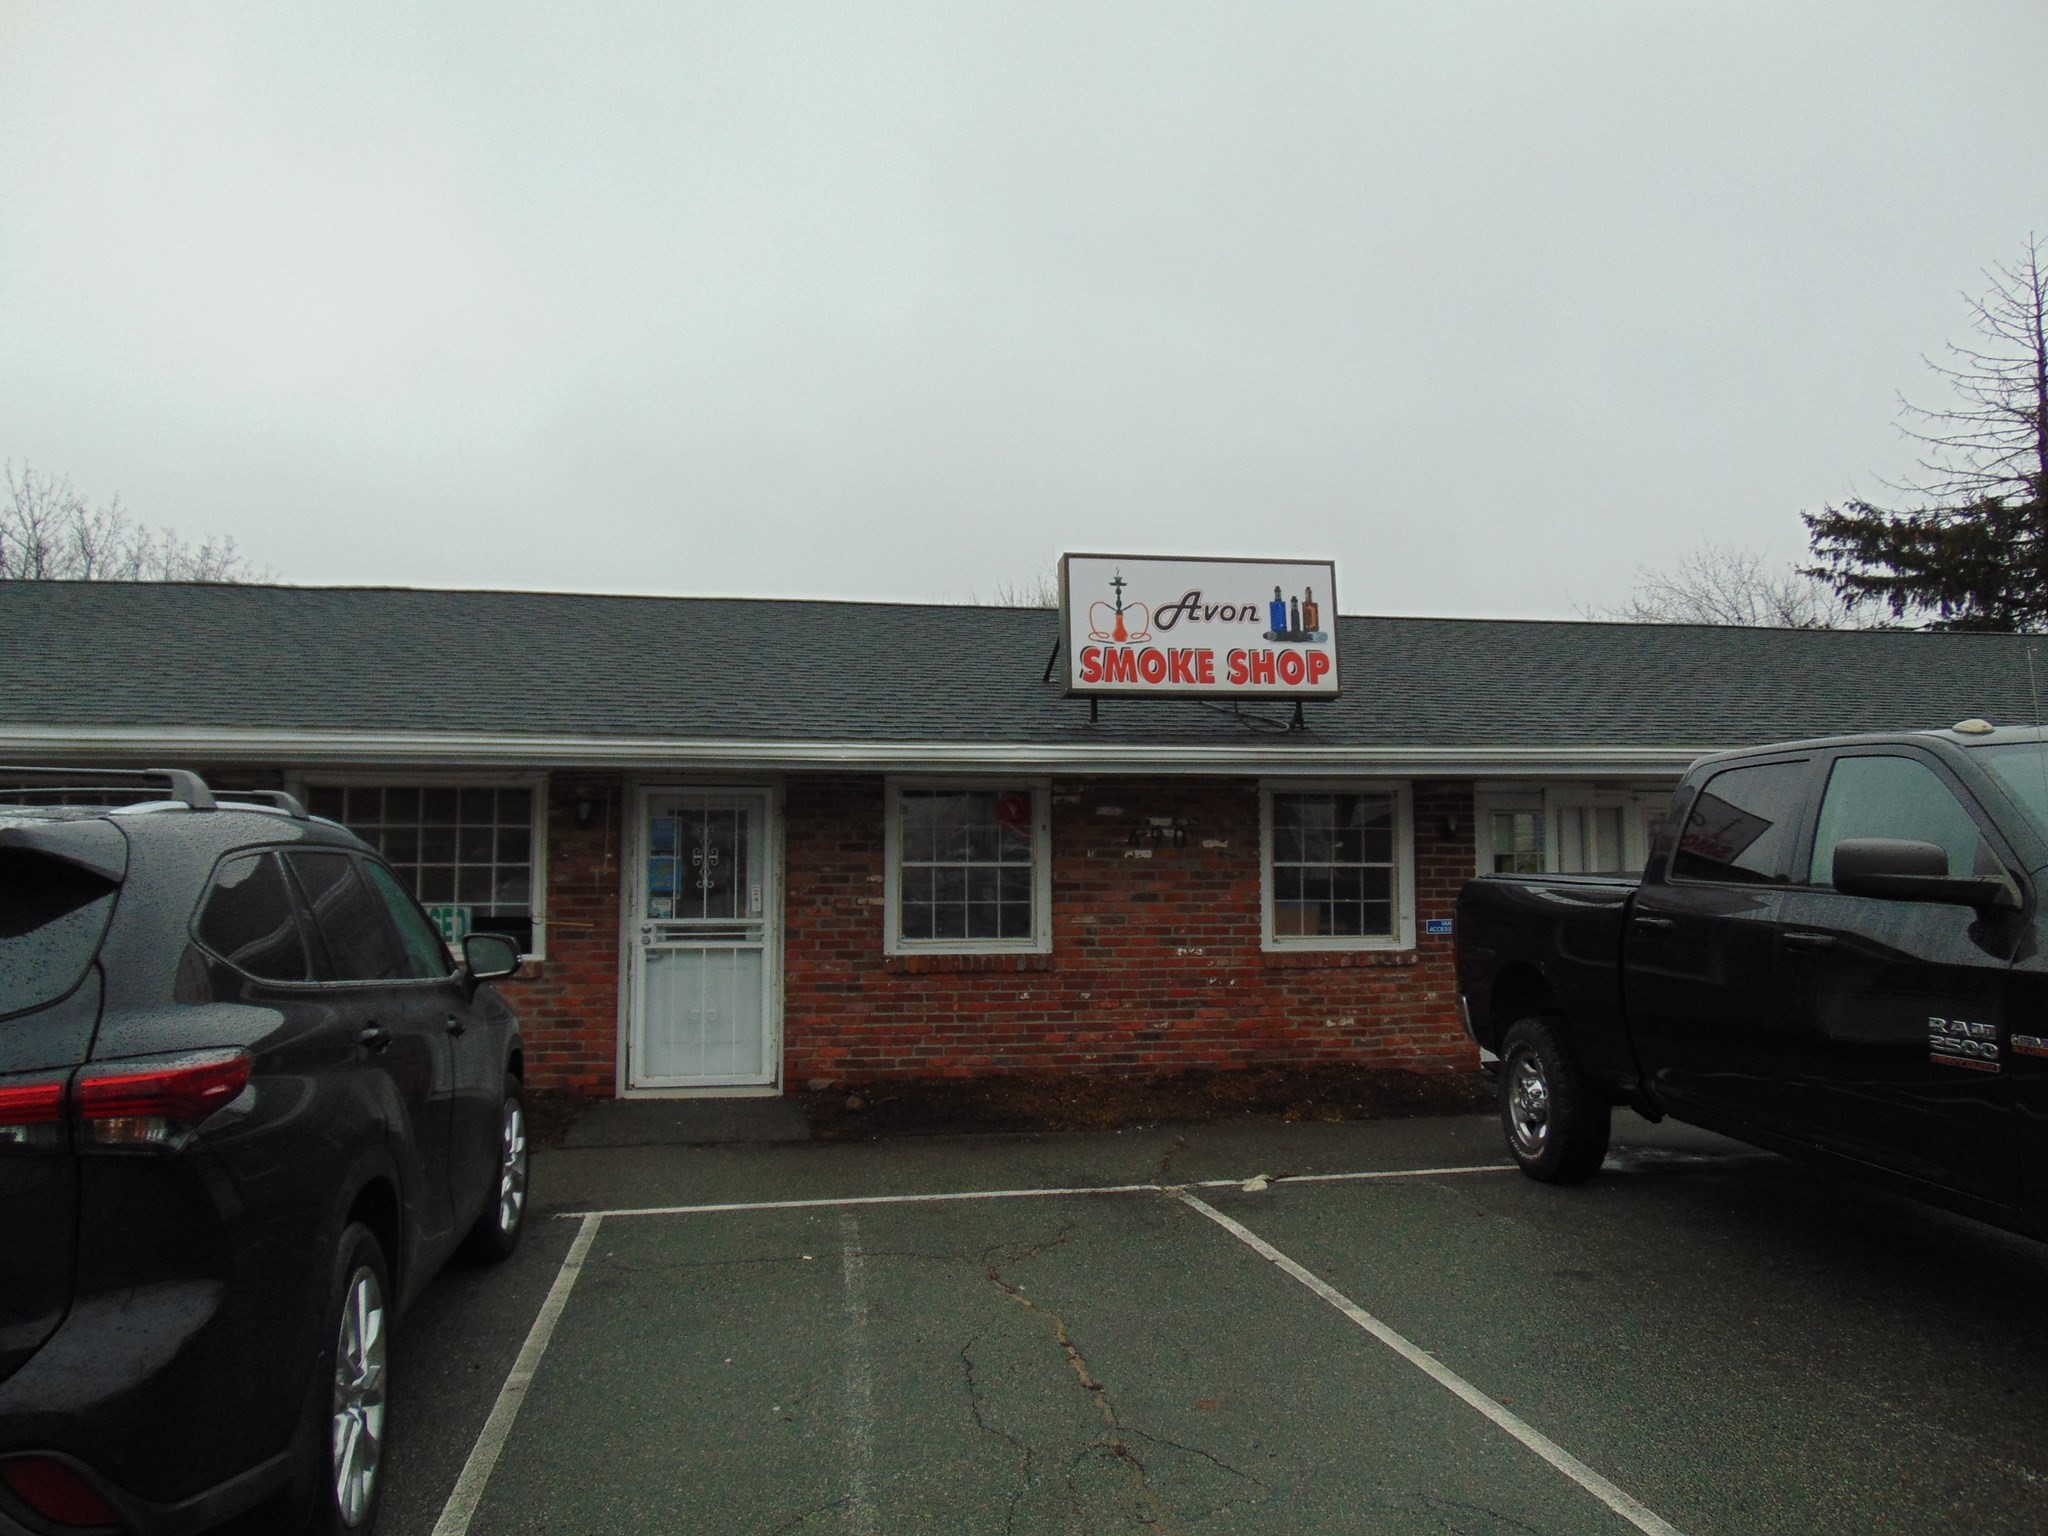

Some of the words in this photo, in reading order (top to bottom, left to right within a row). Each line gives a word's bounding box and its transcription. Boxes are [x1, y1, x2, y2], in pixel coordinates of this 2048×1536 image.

[1154, 590, 1260, 631] Avon
[1080, 646, 1216, 684] SMOKE
[1227, 648, 1330, 686] SHOP
[1928, 1016, 1997, 1040] RAM
[1929, 1034, 1999, 1059] 2500
